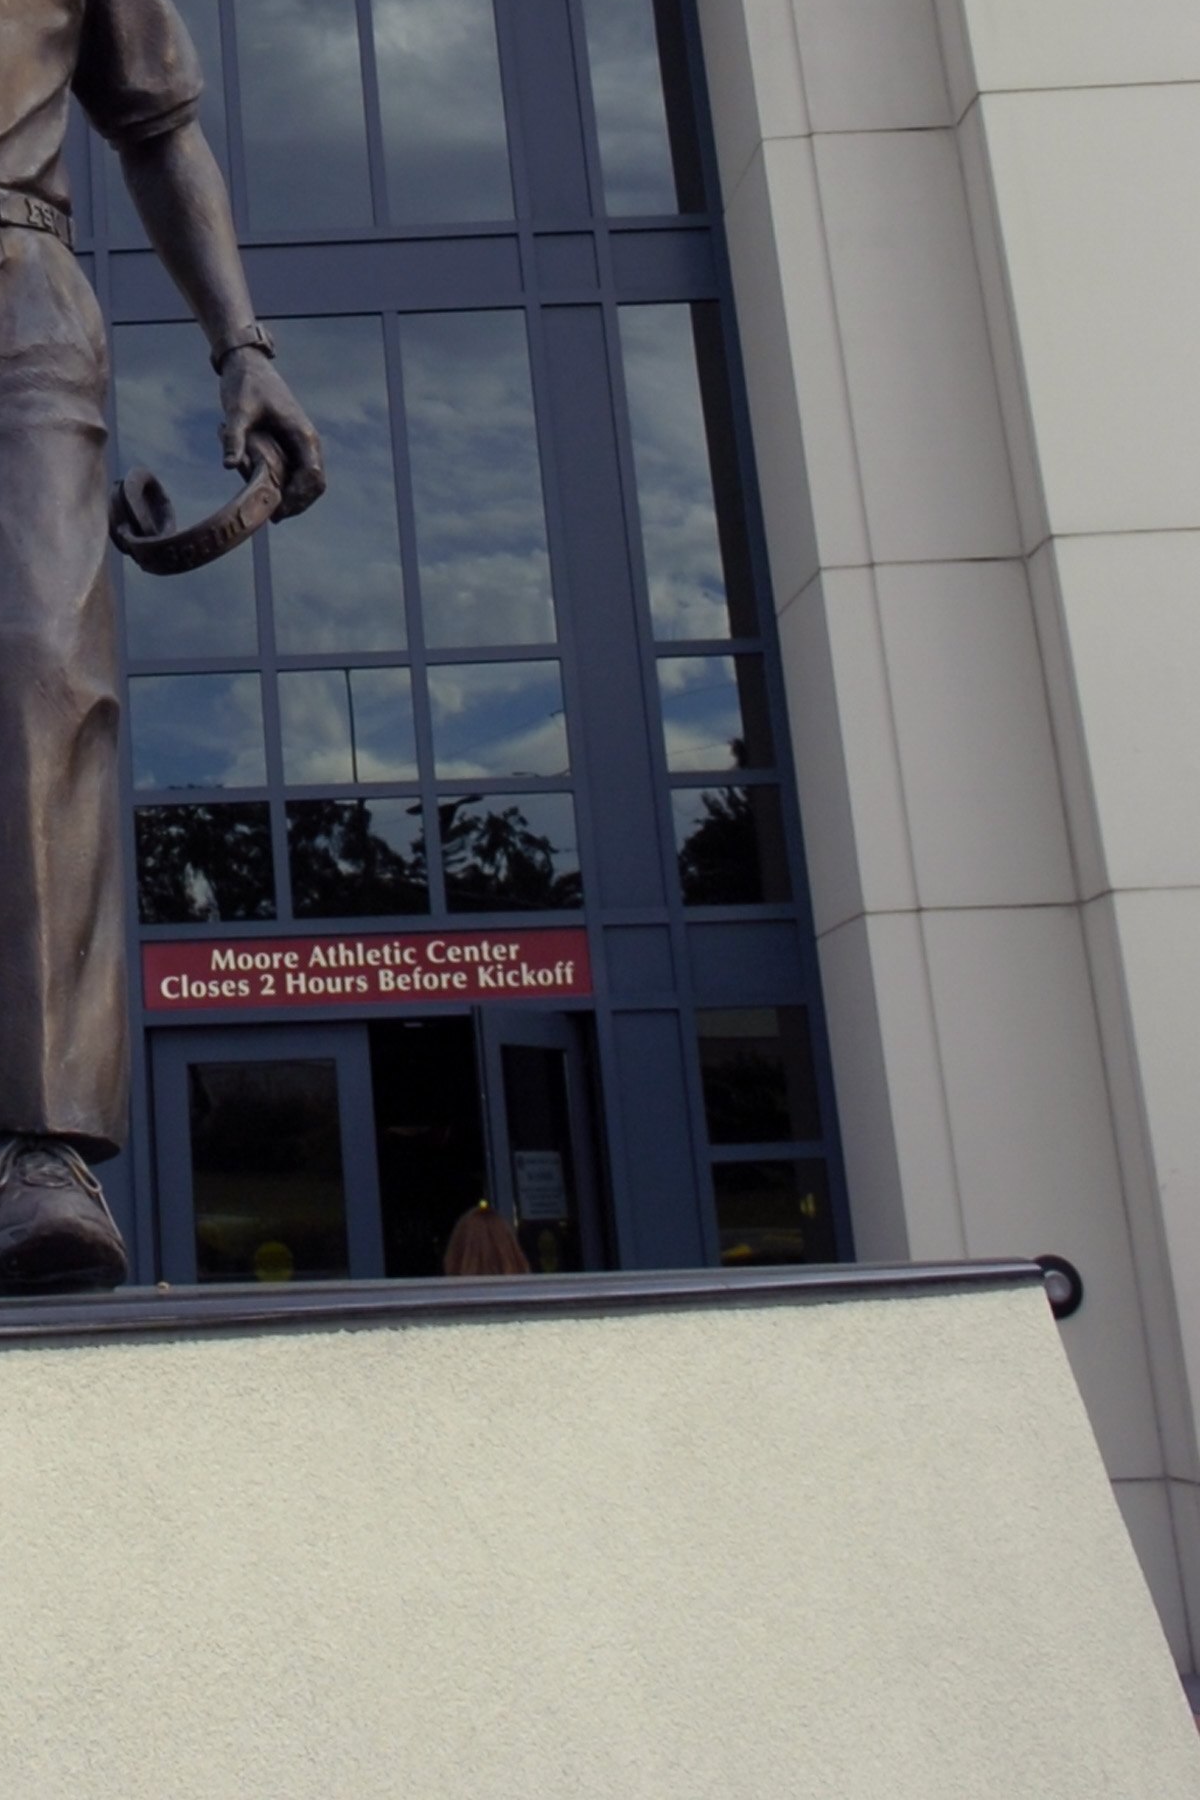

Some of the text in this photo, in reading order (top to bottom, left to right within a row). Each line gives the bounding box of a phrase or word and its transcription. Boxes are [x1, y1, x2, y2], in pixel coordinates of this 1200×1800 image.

[210, 939, 520, 971] Moore Athletic Center
[160, 960, 575, 1000] Closes 2 Hours Before Kickoff
